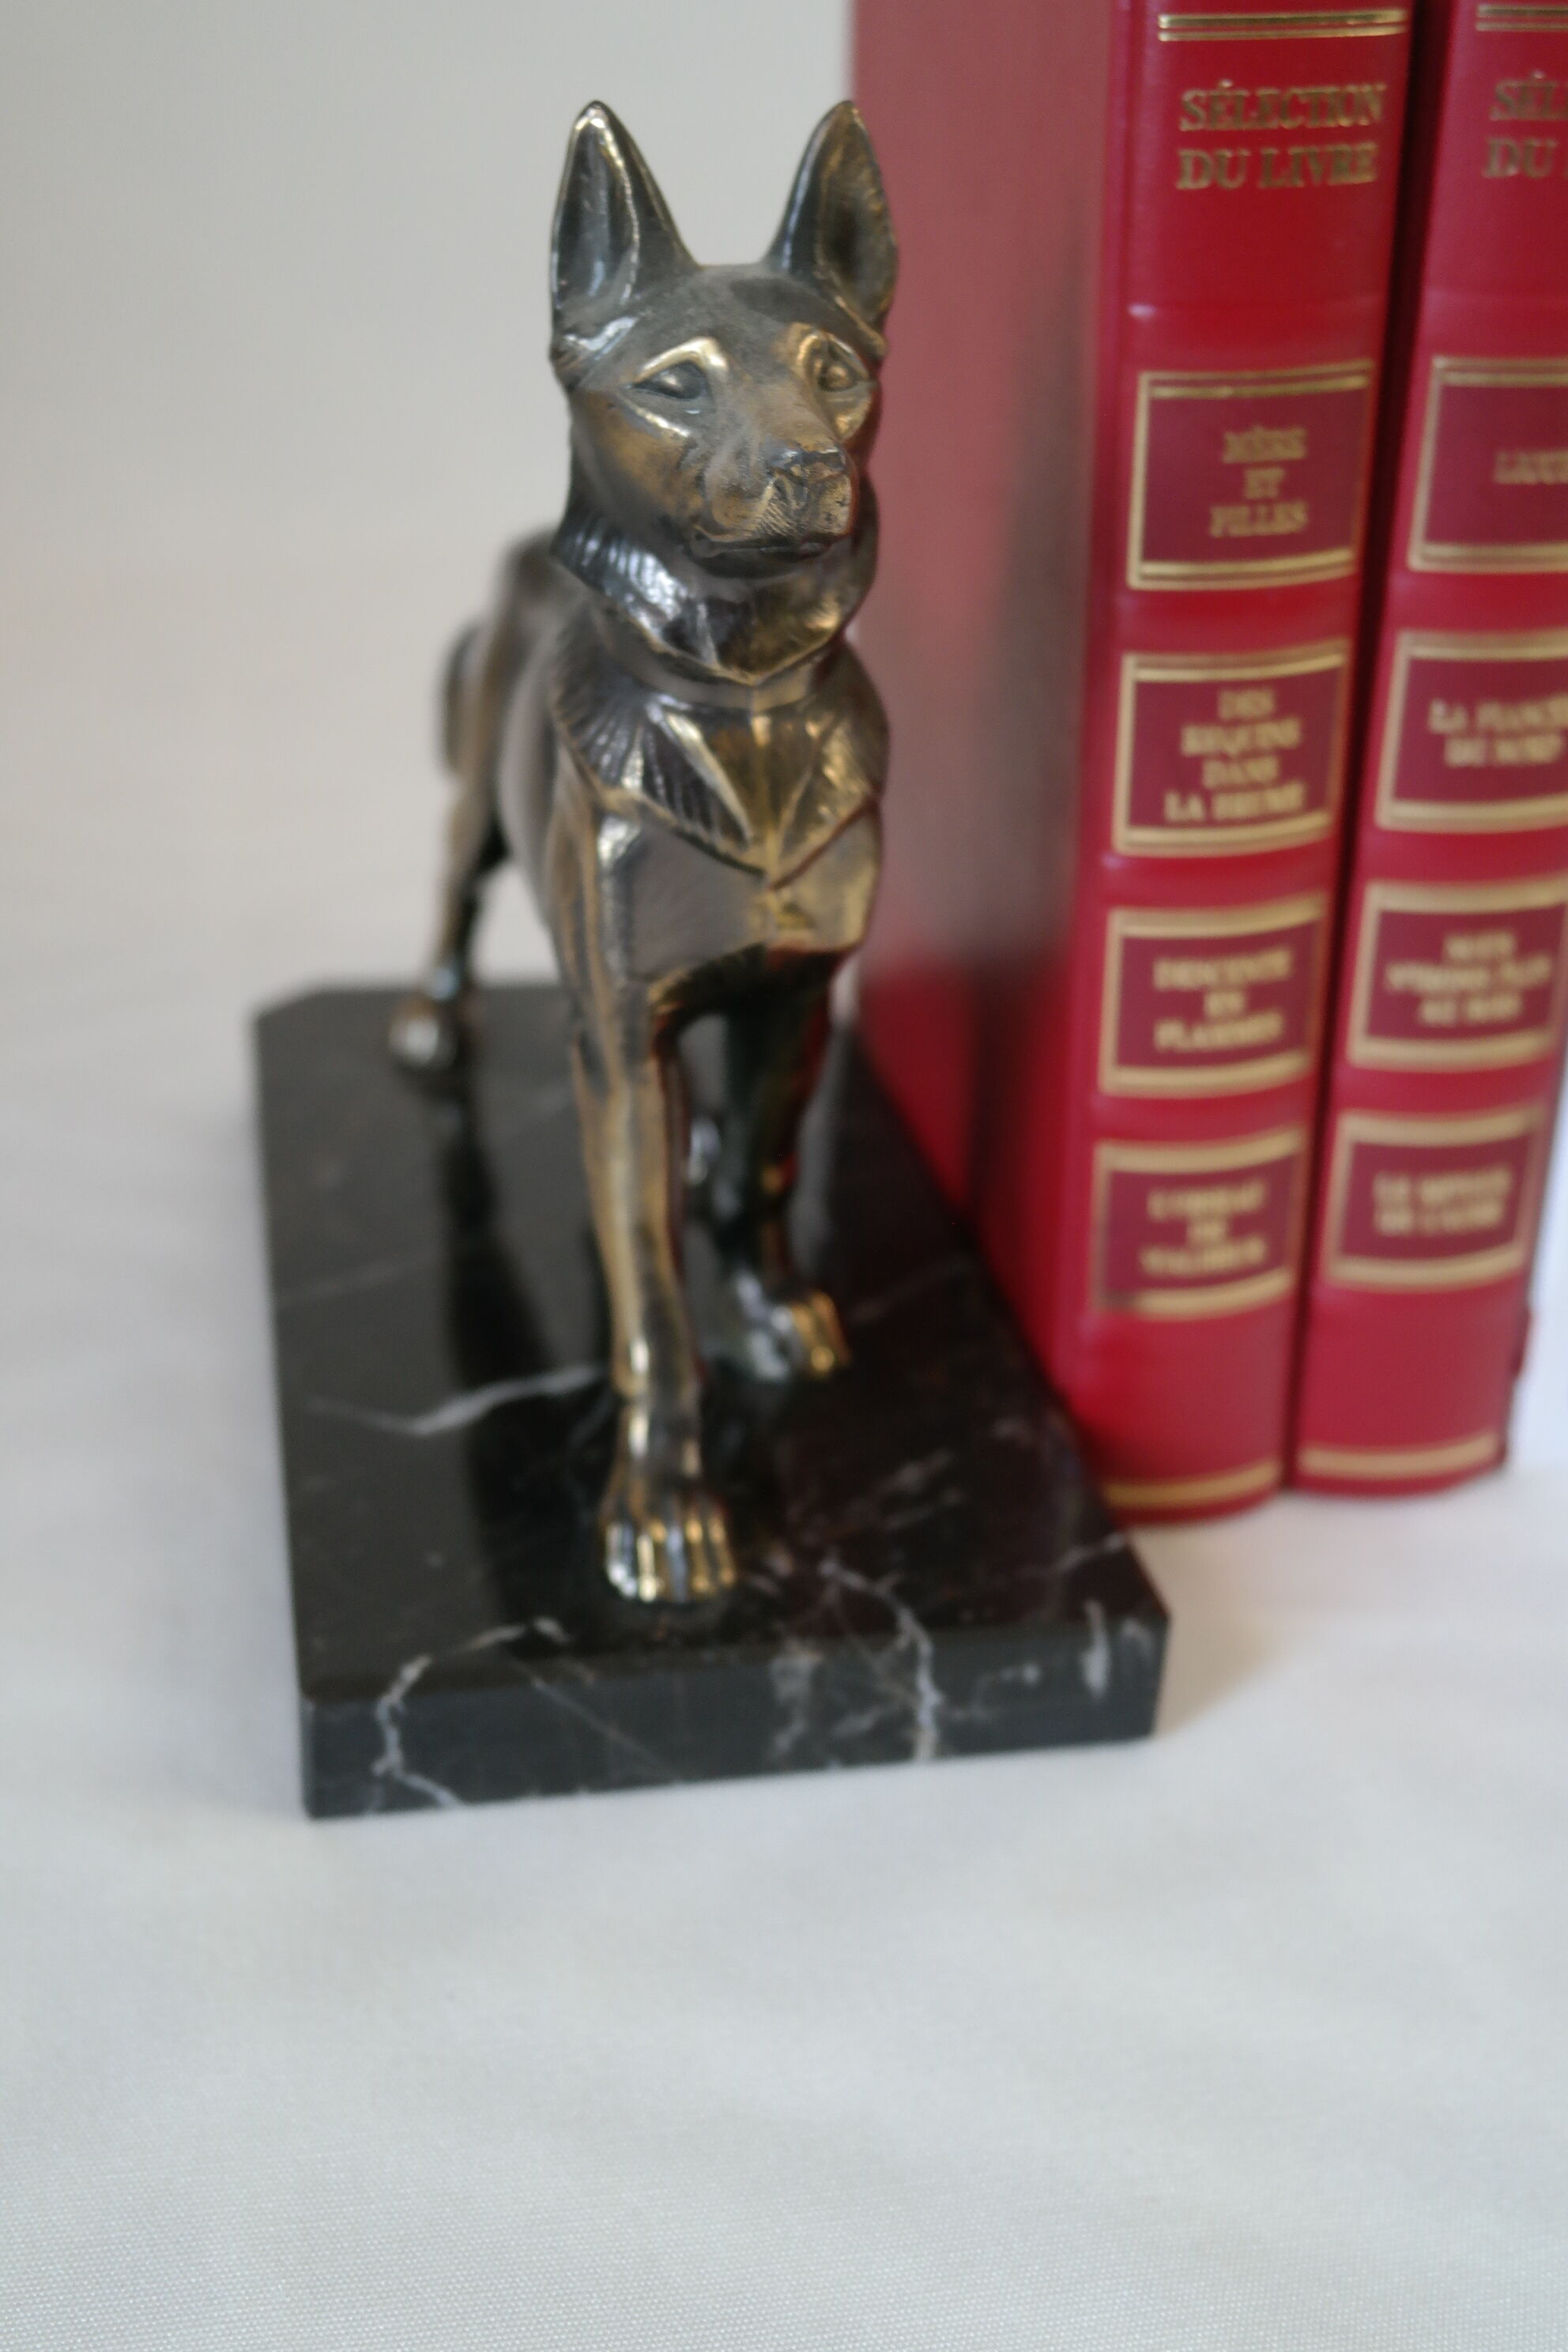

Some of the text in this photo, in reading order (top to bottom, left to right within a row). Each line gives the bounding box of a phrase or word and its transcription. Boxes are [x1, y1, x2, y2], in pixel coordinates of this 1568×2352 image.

[1178, 79, 1387, 131] SÉLECTION
[1490, 70, 1568, 120] SÉL
[1176, 141, 1378, 190] DU LIVRE
[1483, 137, 1558, 178] DU
[1163, 792, 1204, 822] LA
